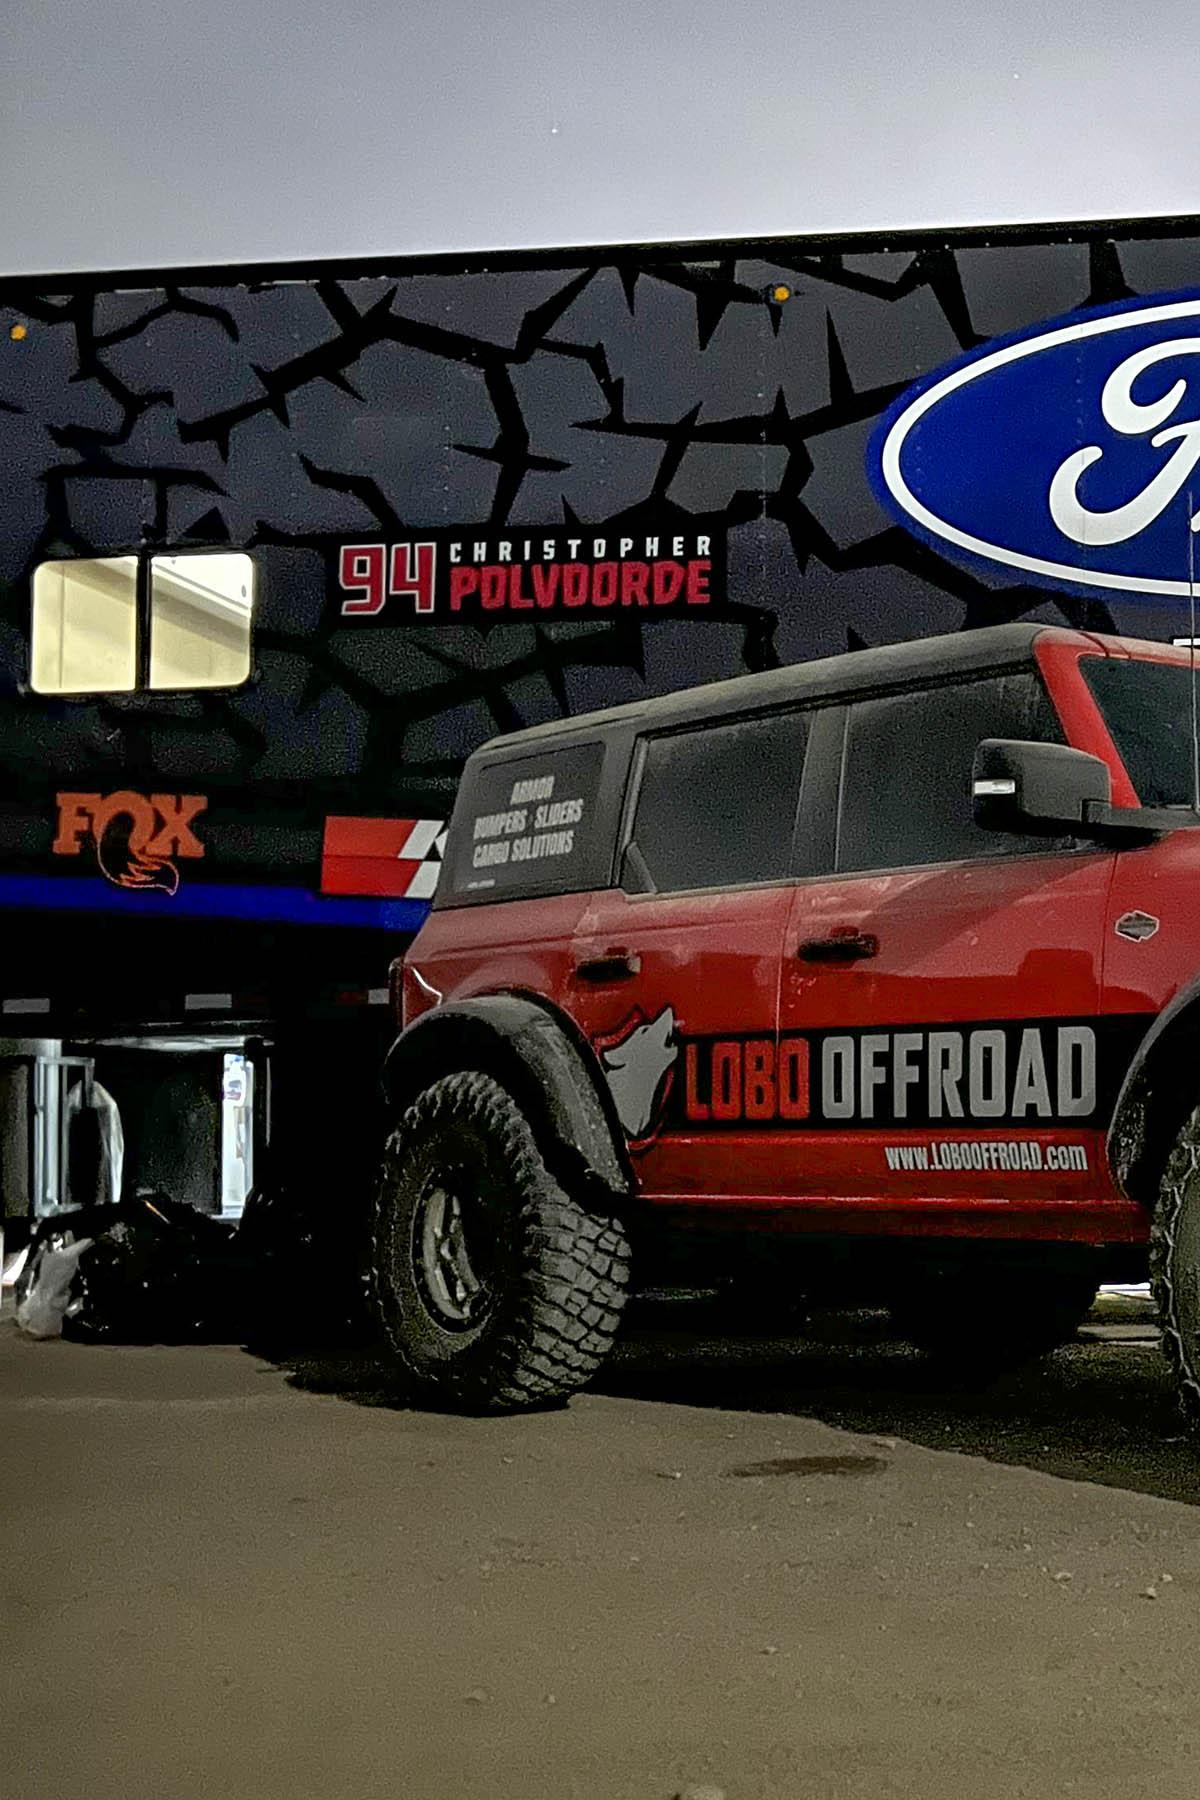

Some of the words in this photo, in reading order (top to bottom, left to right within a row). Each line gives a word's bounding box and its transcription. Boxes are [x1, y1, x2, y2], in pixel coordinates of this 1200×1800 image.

[450, 535, 711, 563] CHRISTOPHER
[339, 543, 437, 616] 94
[450, 560, 712, 611] POLVOORDE
[52, 790, 208, 860] FOX
[534, 798, 584, 829] SLIDERS
[511, 830, 574, 861] SOLUTIONS
[685, 1037, 810, 1121] LOBO
[822, 1026, 1097, 1119] OFFROAD
[885, 1141, 1088, 1171] www.LOBOOFFROAD.com
